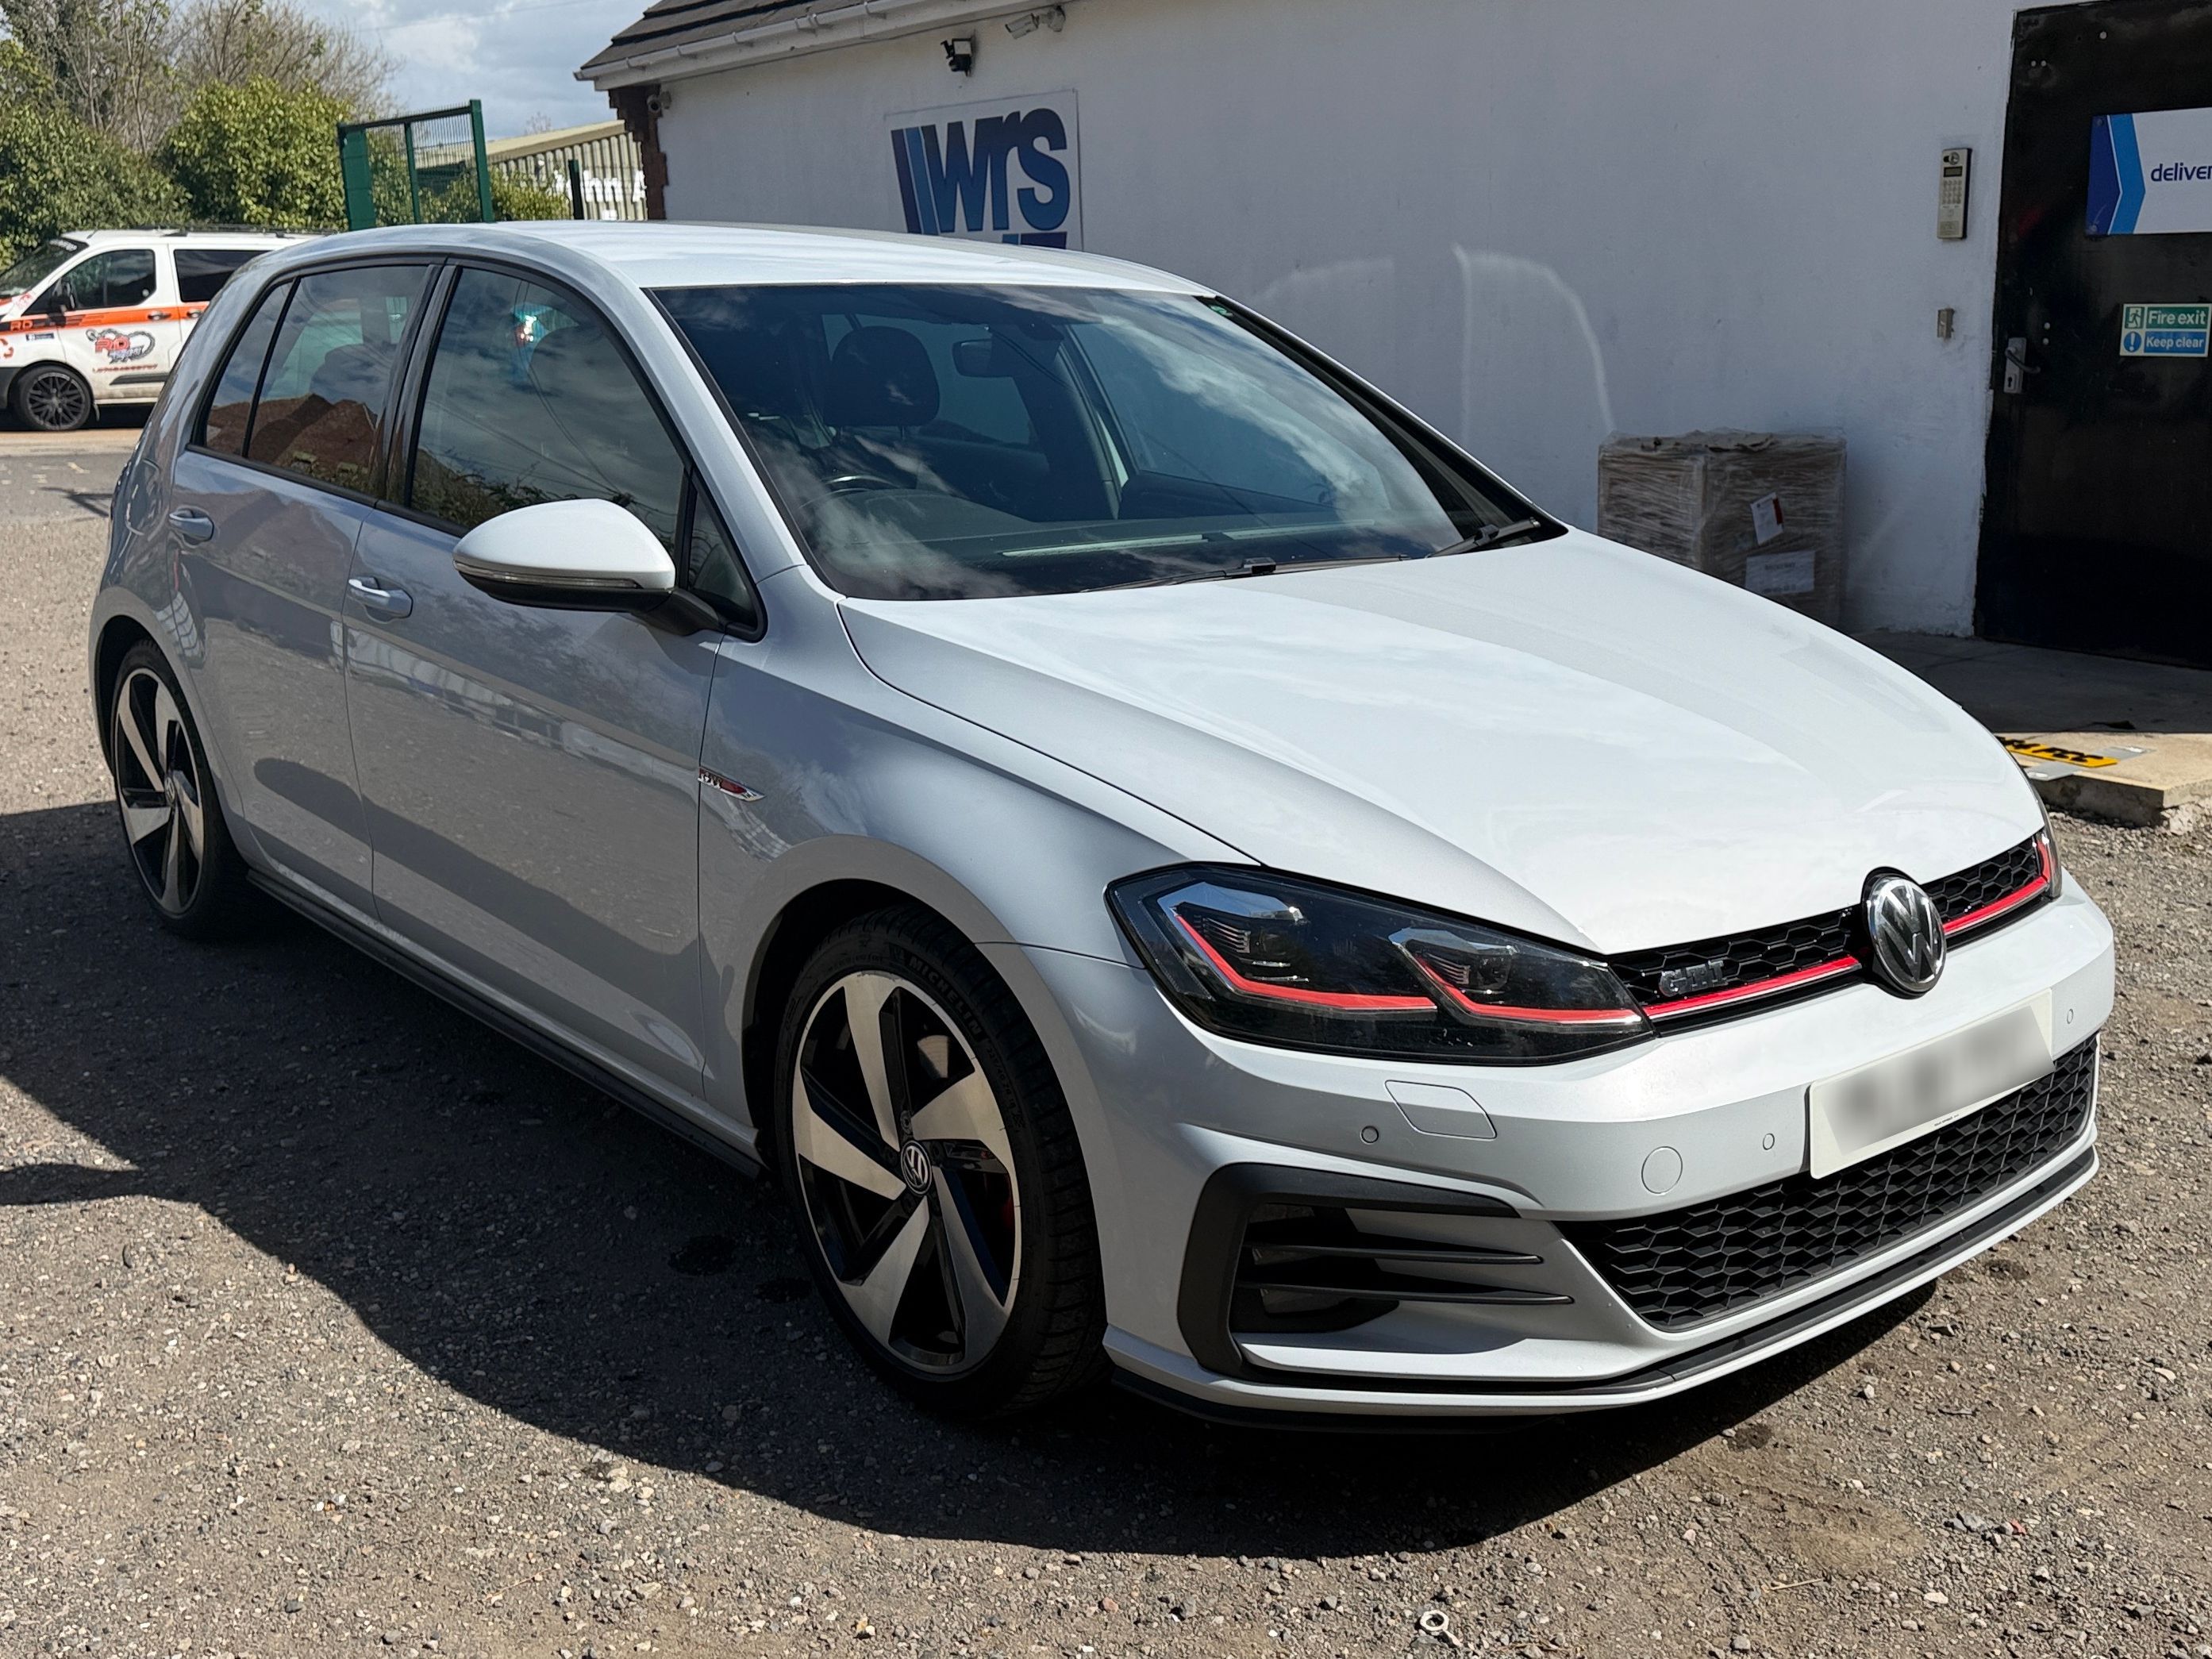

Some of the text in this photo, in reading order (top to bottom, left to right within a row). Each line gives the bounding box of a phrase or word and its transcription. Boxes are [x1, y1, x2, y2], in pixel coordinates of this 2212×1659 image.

[2147, 310, 2206, 325] Fire exit
[2145, 336, 2204, 350] Keep clear
[907, 955, 983, 1037] MICHELIN
